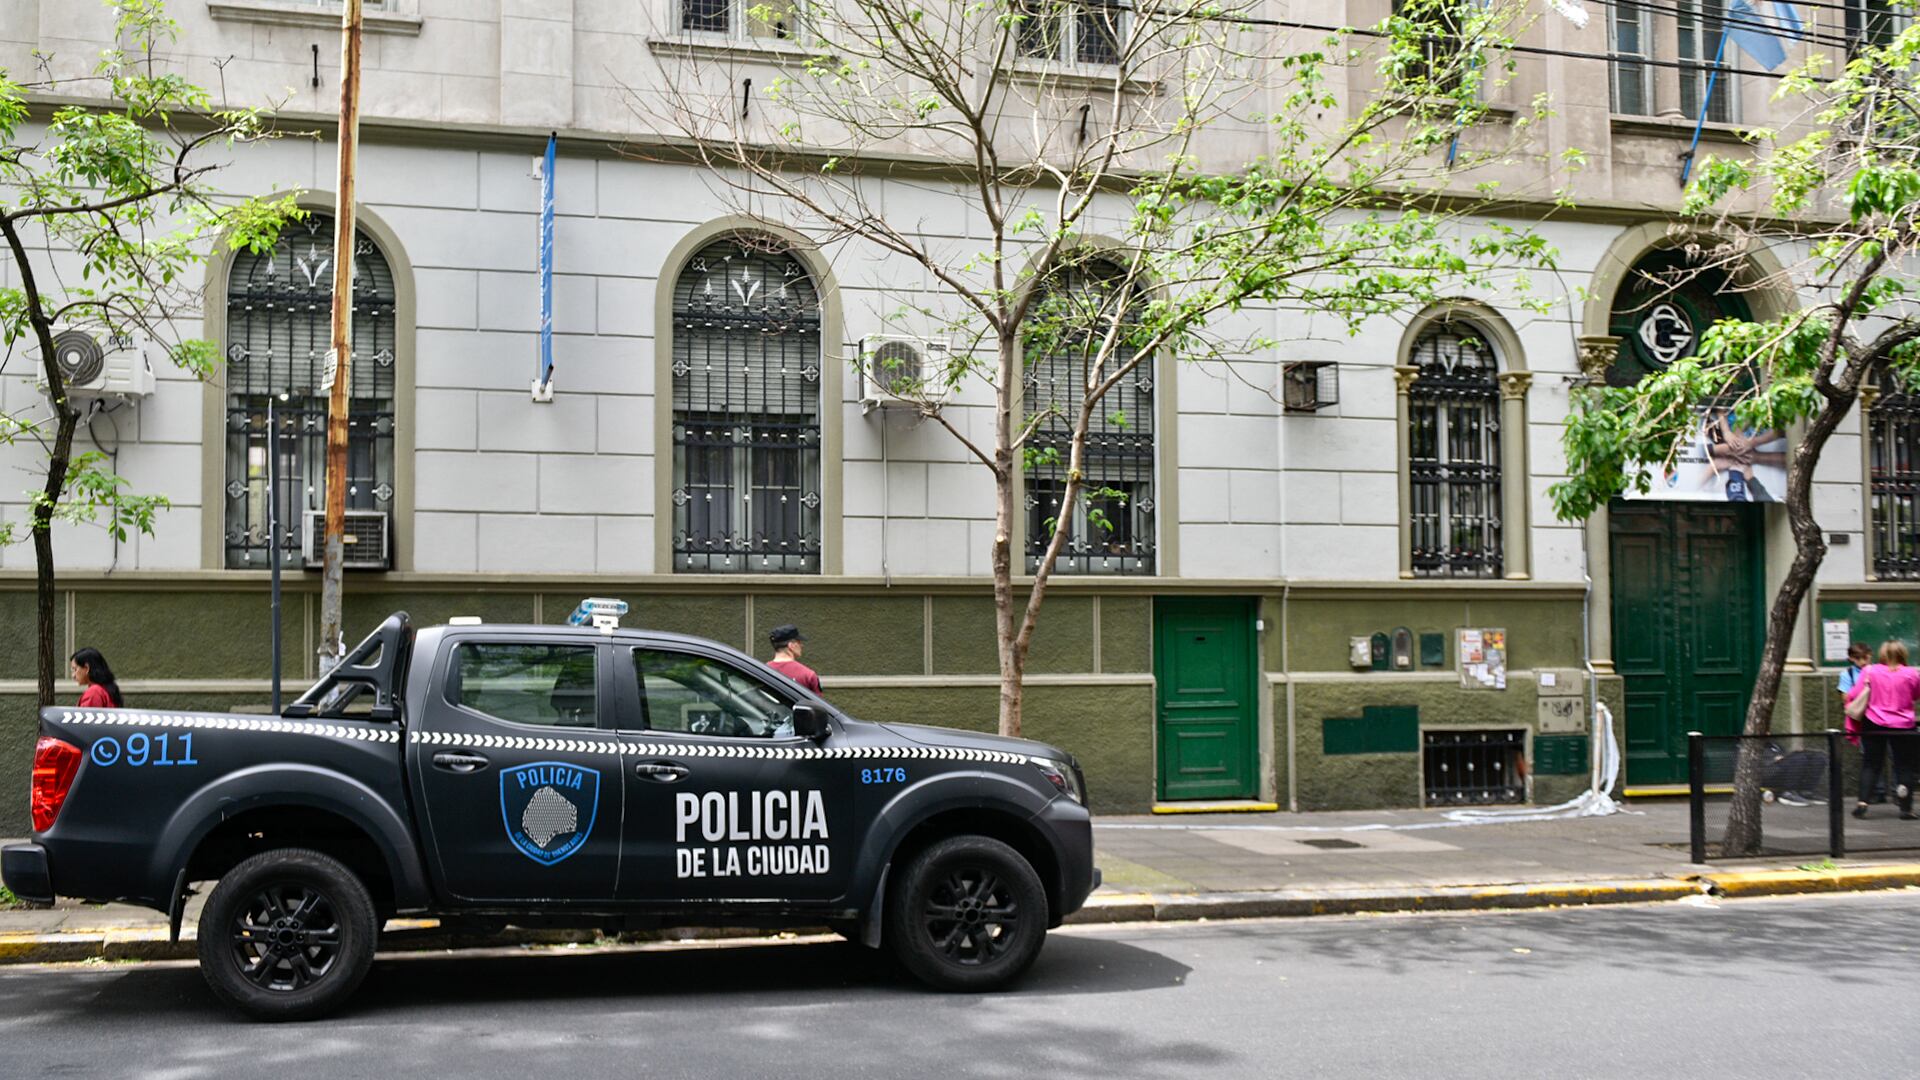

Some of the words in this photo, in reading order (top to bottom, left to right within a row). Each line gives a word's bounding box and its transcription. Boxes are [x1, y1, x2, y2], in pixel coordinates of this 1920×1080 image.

[126, 732, 198, 767] 911
[515, 767, 583, 790] POLICIA
[861, 767, 906, 784] 8176
[676, 790, 829, 842] POLICIA
[677, 848, 706, 878] DE
[713, 847, 741, 876] LA
[747, 845, 830, 875] CIUDAD
